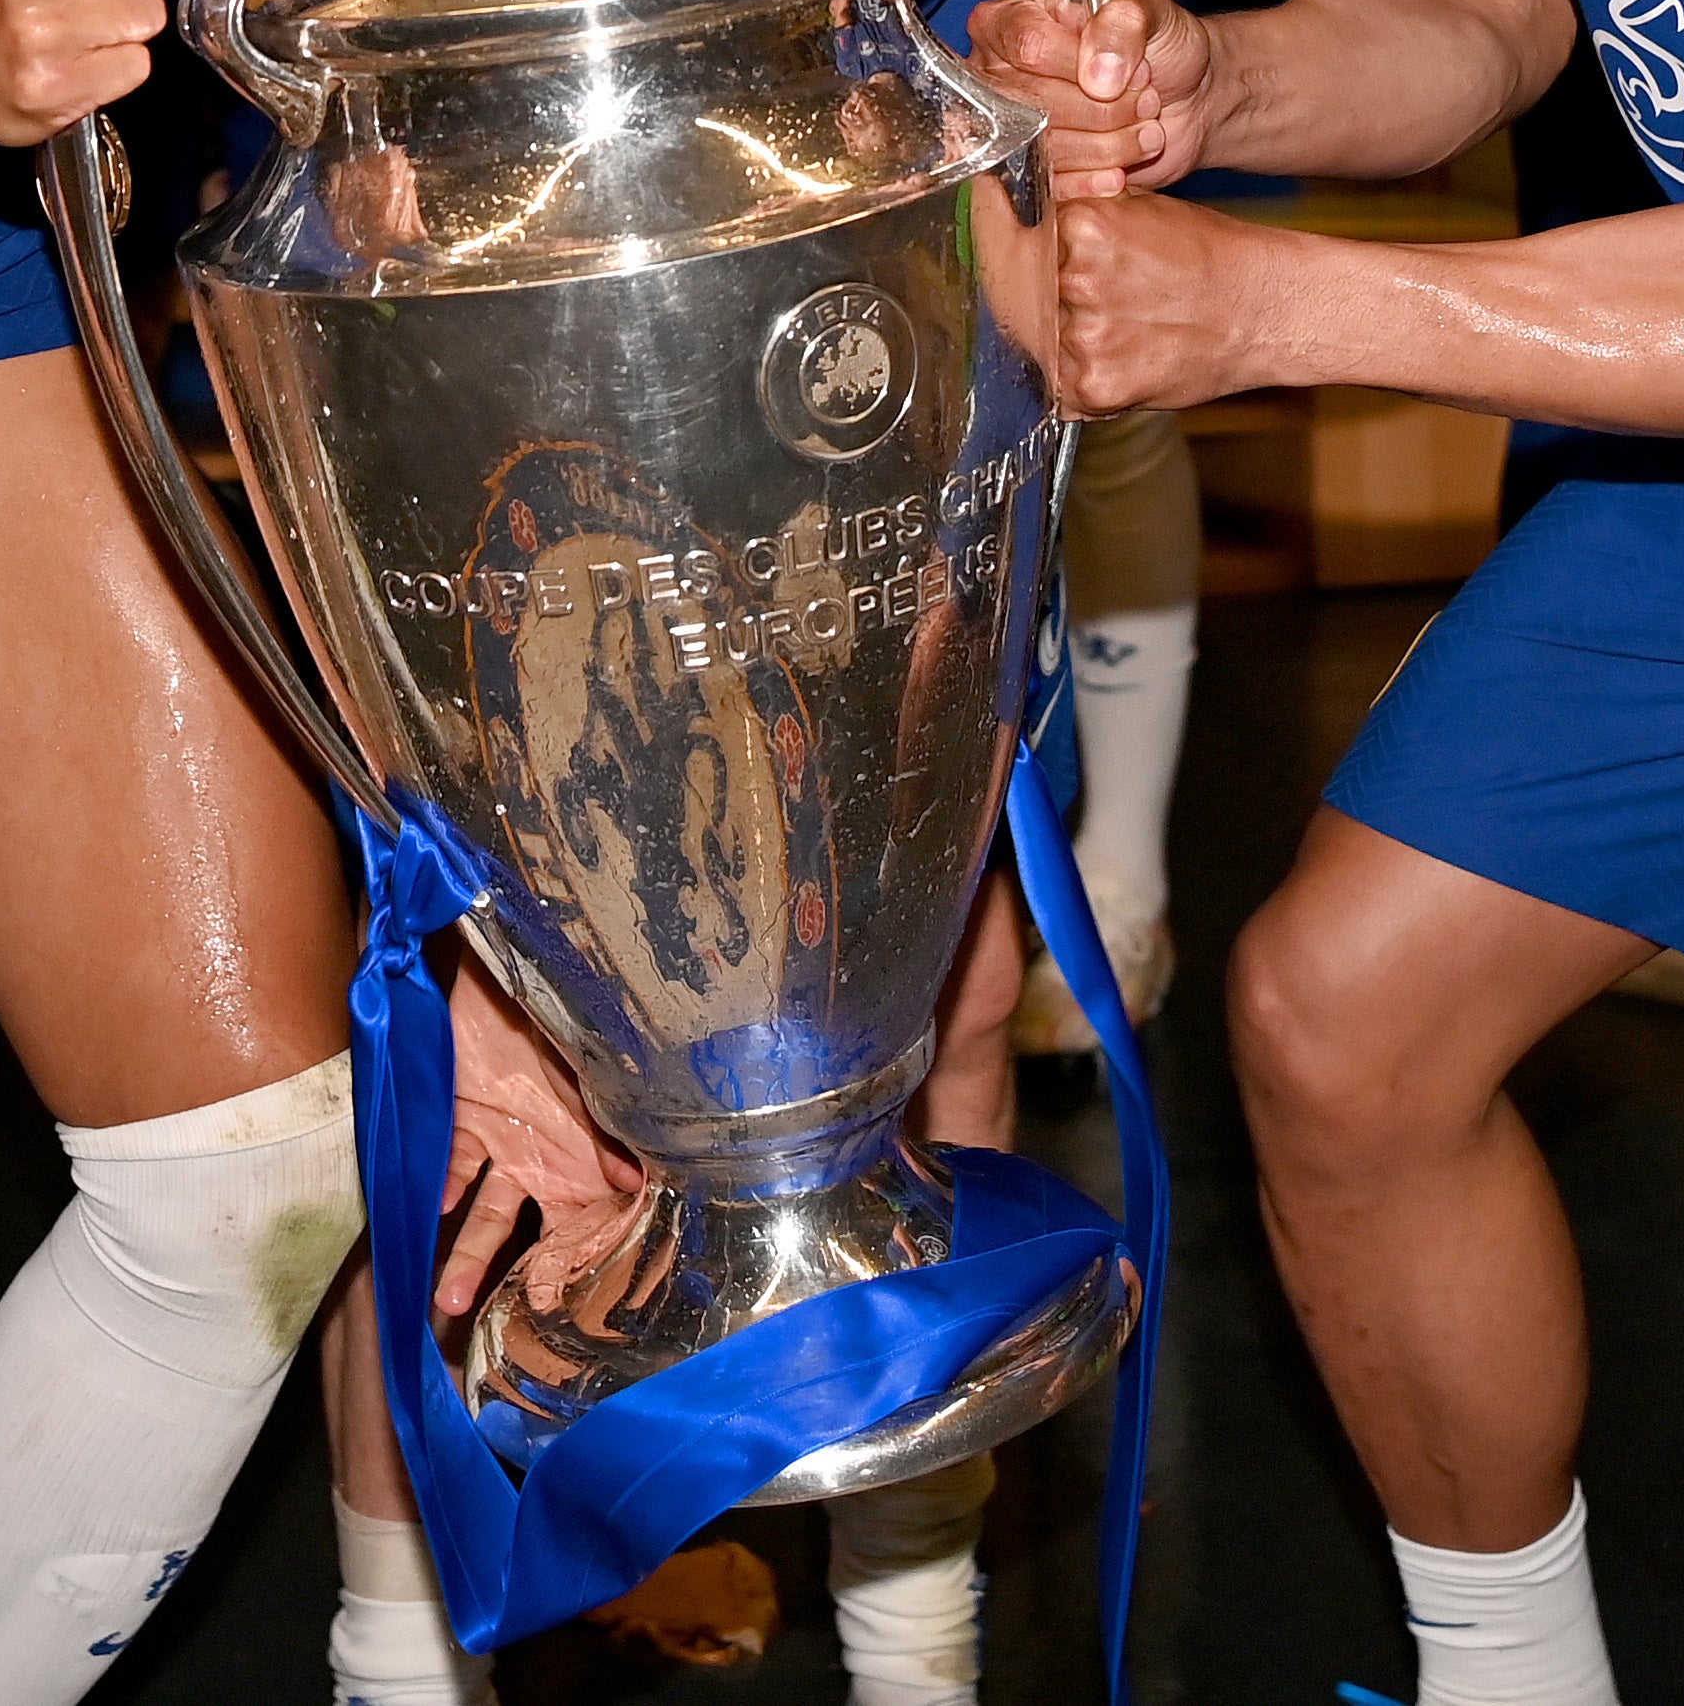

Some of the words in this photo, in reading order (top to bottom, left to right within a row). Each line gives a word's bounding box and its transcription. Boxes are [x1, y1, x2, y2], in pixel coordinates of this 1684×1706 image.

[784, 295, 884, 343] UEFA
[378, 568, 575, 619] COUPE
[587, 549, 722, 613] DES
[739, 493, 928, 587] CLUBS
